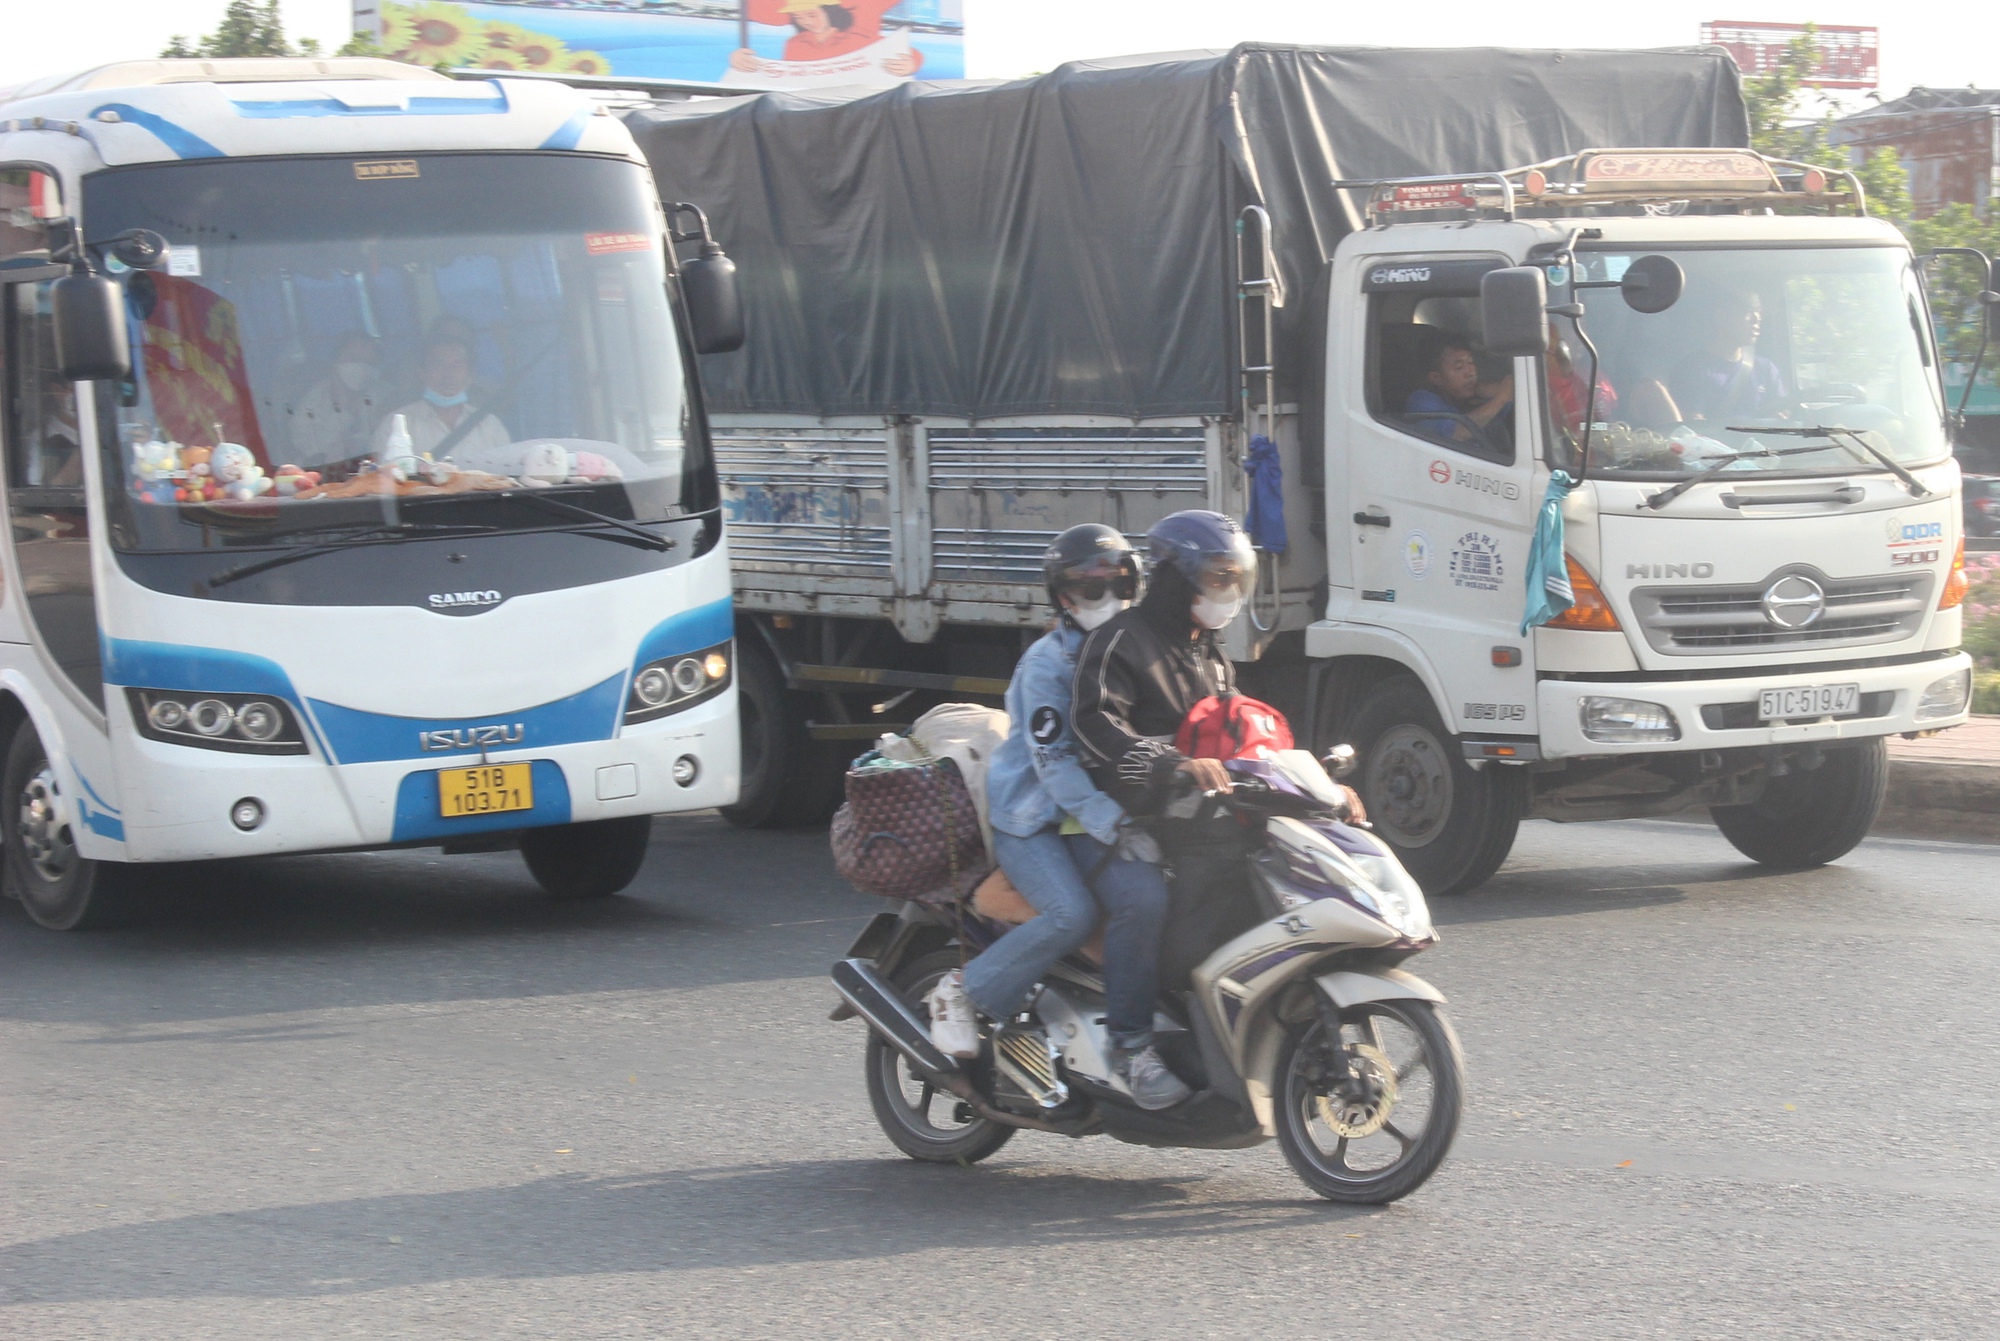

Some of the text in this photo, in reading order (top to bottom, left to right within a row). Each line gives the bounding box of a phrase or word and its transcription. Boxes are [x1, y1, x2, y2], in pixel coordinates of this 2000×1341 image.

[1454, 469, 1520, 501] HINO
[1902, 522, 1942, 540] QDR
[1891, 550, 1939, 567] 500
[1626, 562, 1714, 579] HINO
[428, 590, 502, 605] SAMCO
[1464, 702, 1525, 721] 165 PS
[1762, 687, 1856, 716] 51C-519.47
[419, 723, 525, 752] ISUZU
[465, 768, 505, 790] 51B
[453, 788, 521, 814] 103.71
